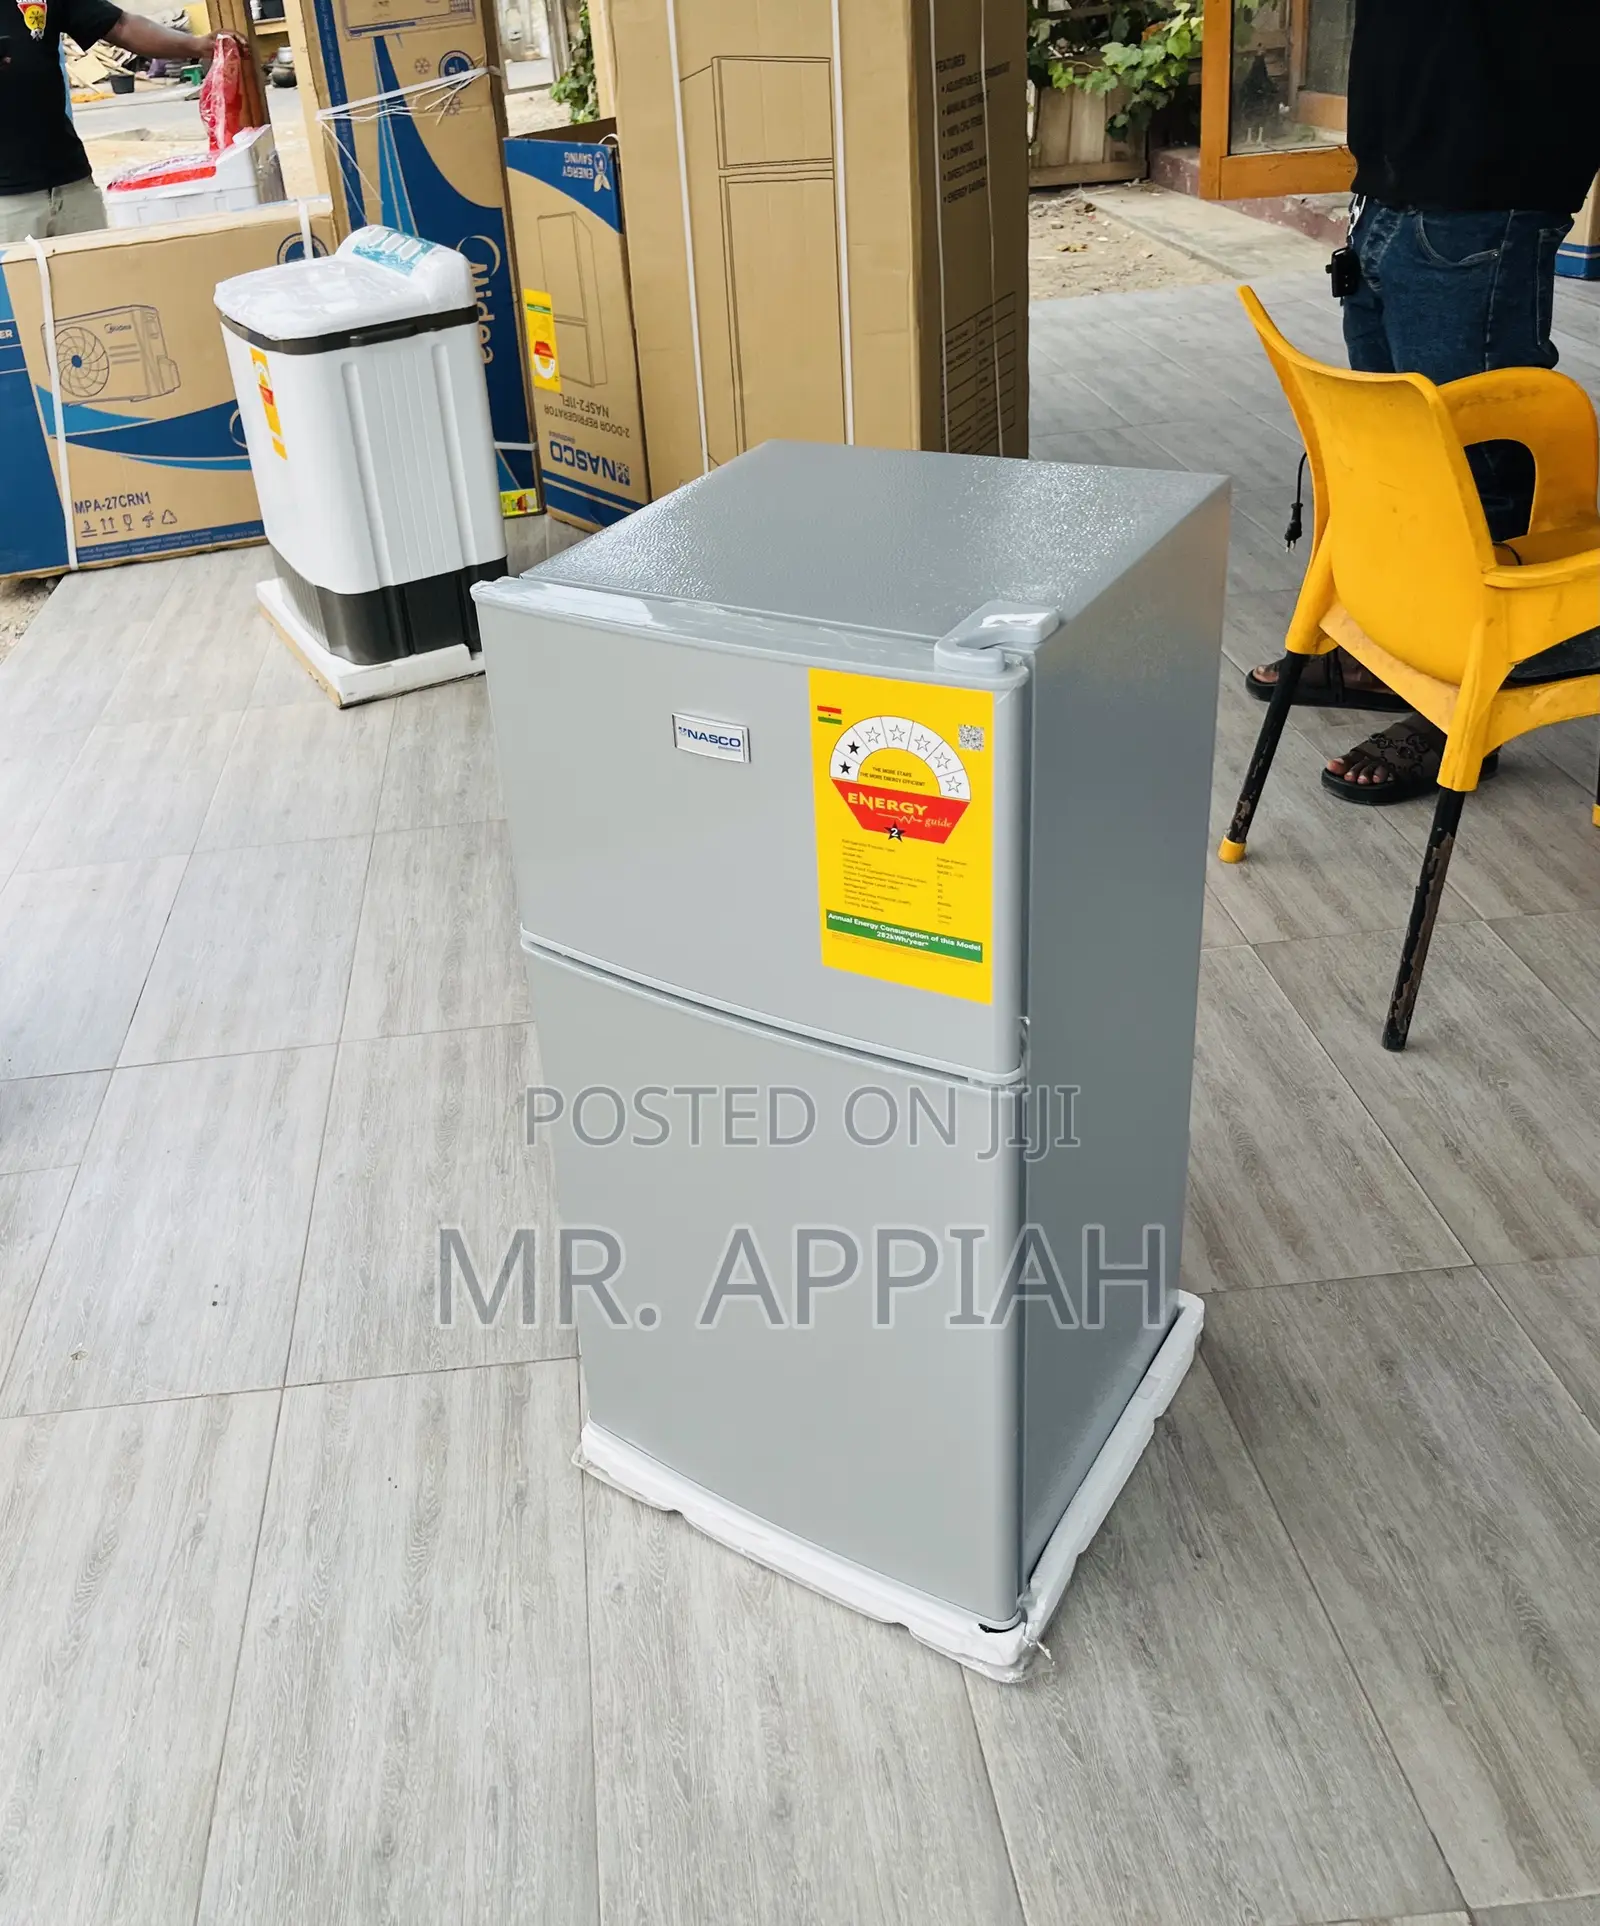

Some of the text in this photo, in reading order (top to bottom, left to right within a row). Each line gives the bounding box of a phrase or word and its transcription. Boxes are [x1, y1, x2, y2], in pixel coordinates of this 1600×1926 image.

[564, 151, 593, 166] SAVING
[562, 165, 594, 180] ENERGY
[560, 392, 610, 419] NASF2-11FL
[543, 403, 631, 438] 2-DOOR REFRIGERATOR
[549, 440, 616, 482] NASCO
[74, 491, 151, 514] MPA-27CRN1
[687, 729, 741, 748] NASCO
[869, 773, 883, 781] MORE
[872, 766, 882, 774] THE
[882, 767, 896, 776] MORE
[848, 791, 928, 816] ENERGY
[890, 827, 899, 837] 2
[924, 817, 952, 828] guide
[828, 913, 981, 951] Annual Energy Consumption of this Model
